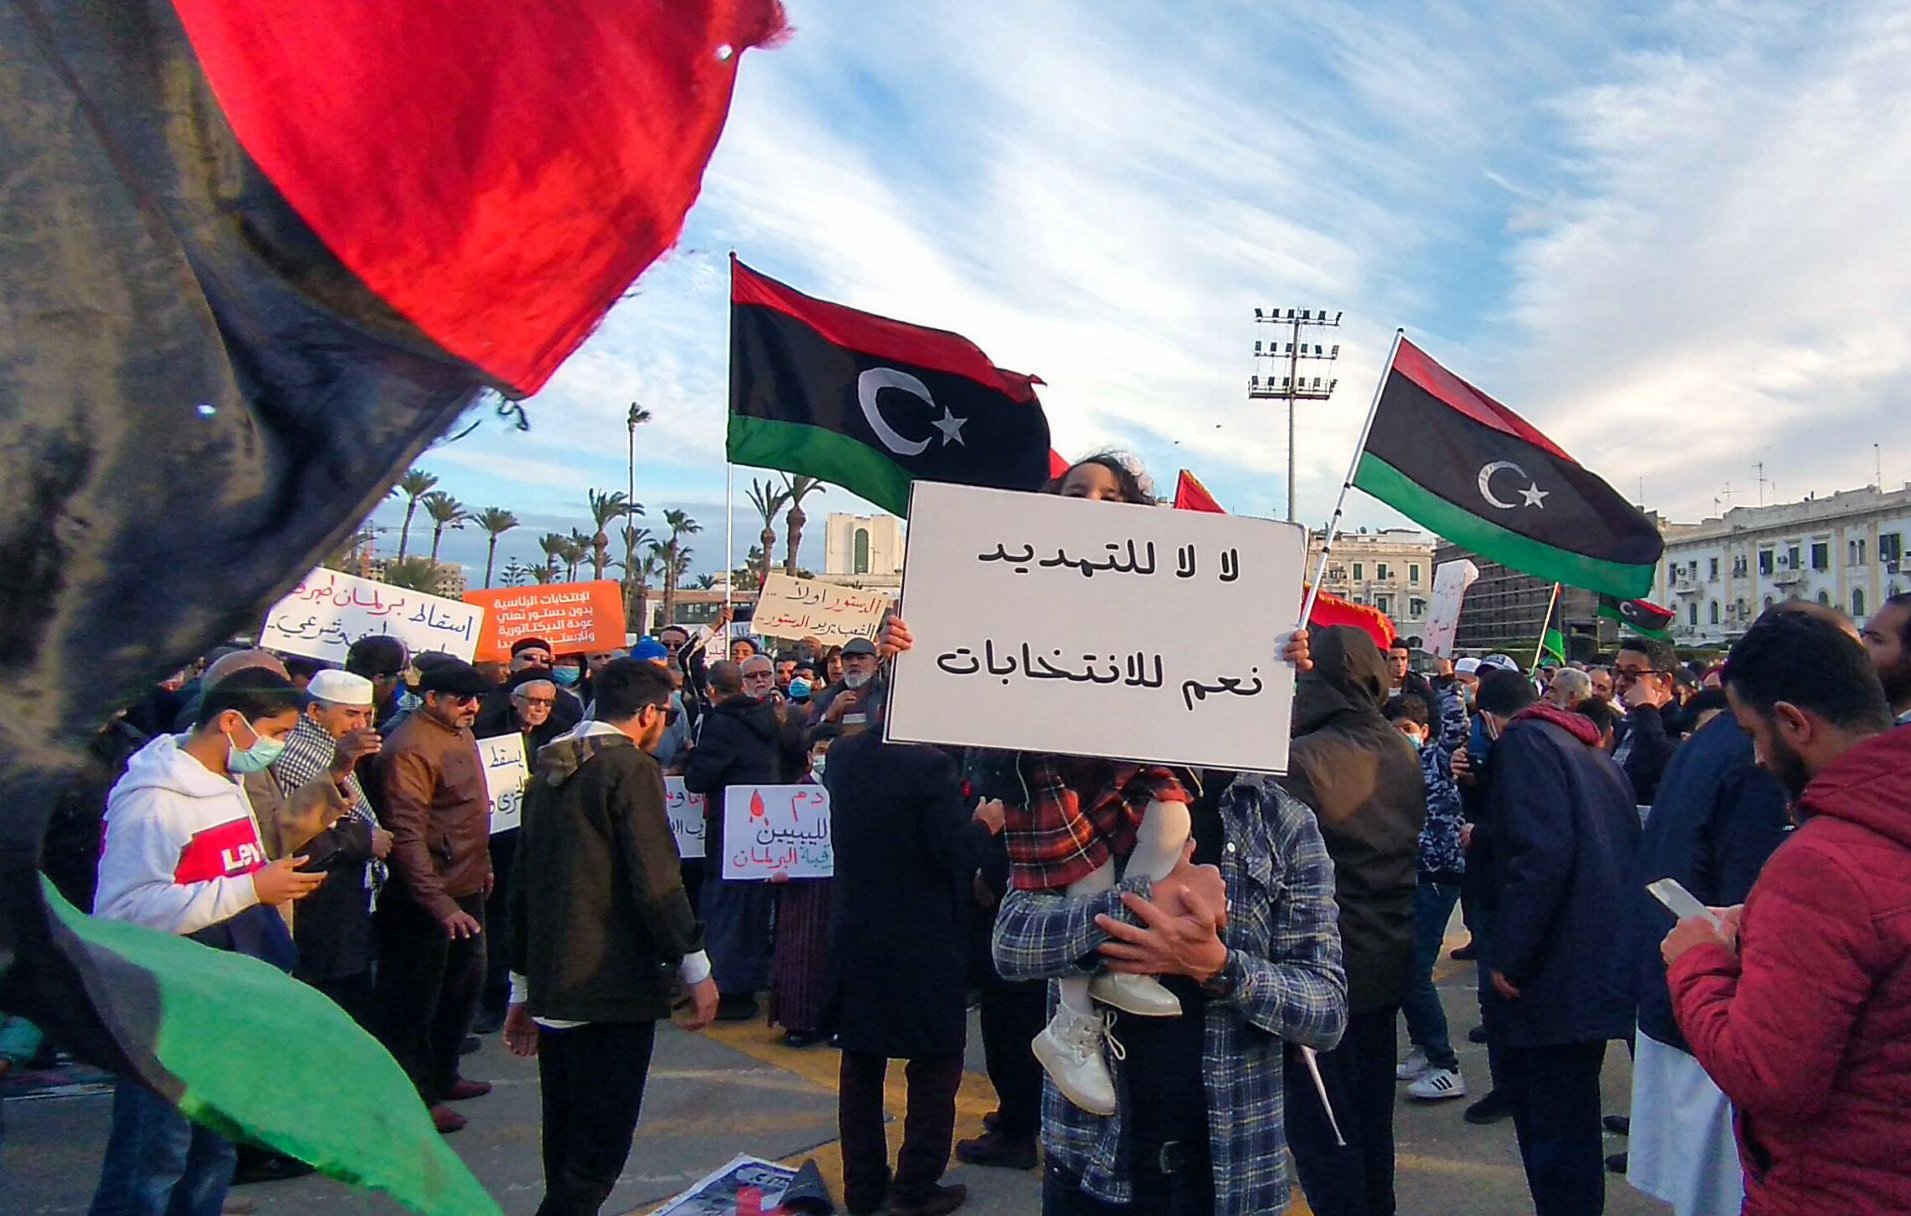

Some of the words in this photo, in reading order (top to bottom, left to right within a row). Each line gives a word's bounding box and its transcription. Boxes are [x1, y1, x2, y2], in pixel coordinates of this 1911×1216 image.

[978, 539, 1156, 578] للتمديد
[1176, 544, 1196, 578] لا
[1219, 548, 1239, 581] لا
[333, 587, 405, 616] برلمان
[568, 606, 593, 617] بدون
[566, 619, 594, 630] عودة
[810, 622, 836, 636] يريد
[937, 639, 1163, 688] للانتخابات
[1182, 667, 1263, 711] نعم
[791, 791, 824, 822] دم
[733, 846, 798, 869] البرلمان
